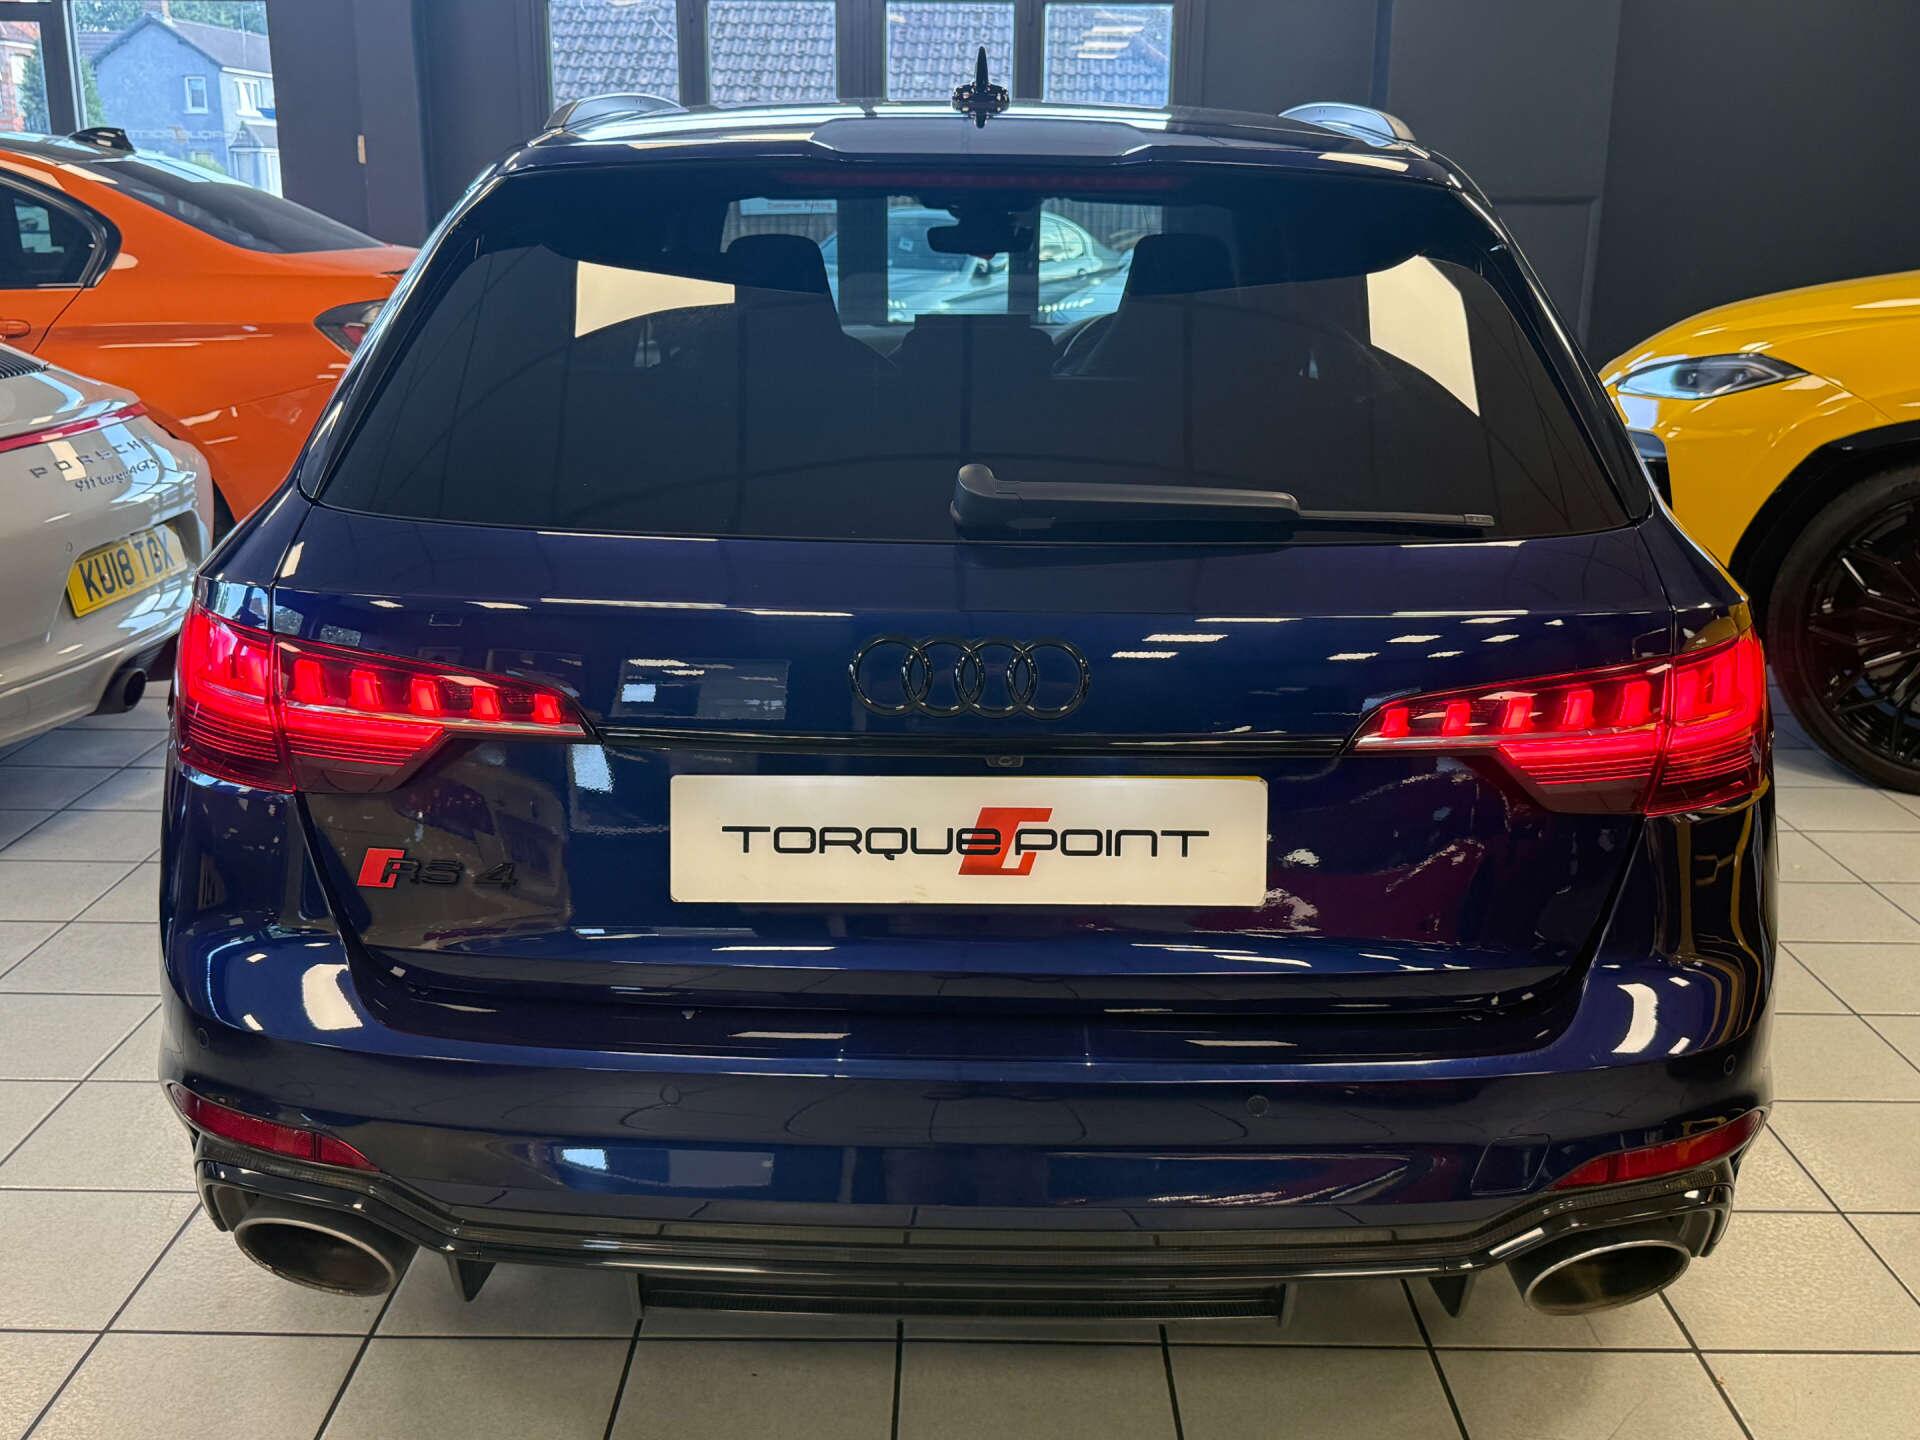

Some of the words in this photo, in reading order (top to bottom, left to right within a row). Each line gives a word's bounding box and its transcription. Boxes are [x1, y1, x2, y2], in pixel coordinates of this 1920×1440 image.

[78, 548, 136, 602] KU18
[133, 531, 175, 577] TBX
[380, 857, 464, 885] RS
[474, 862, 519, 889] 4
